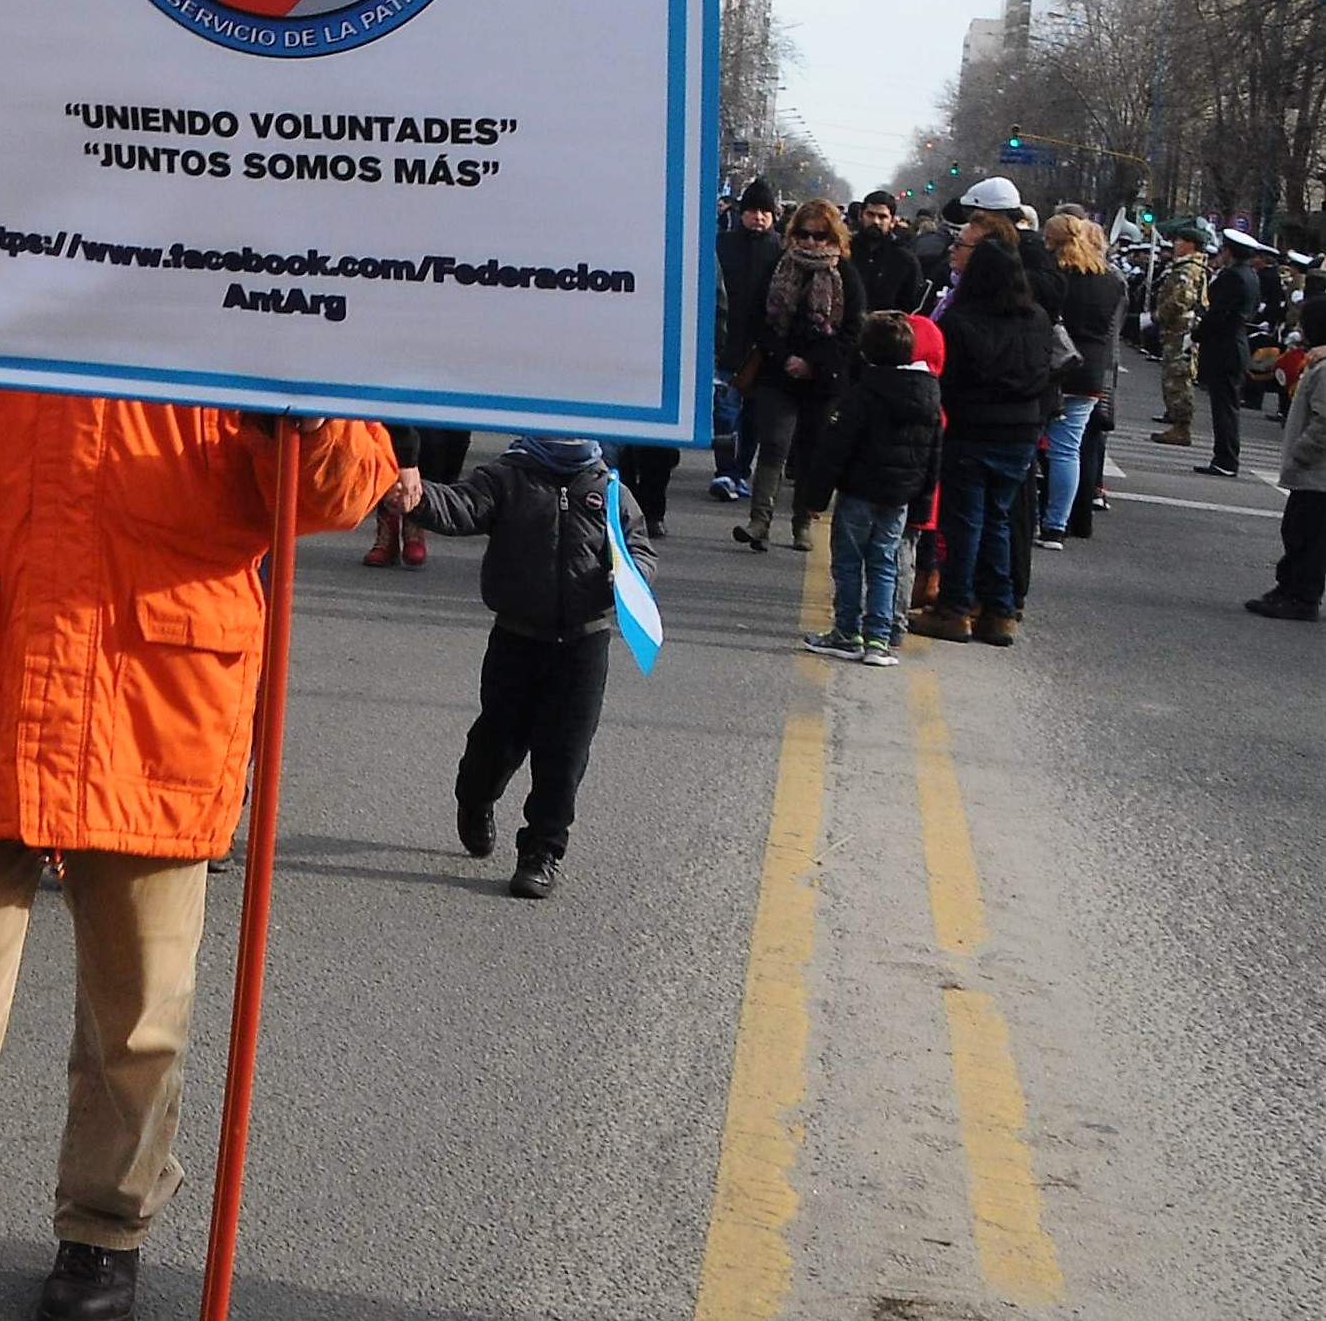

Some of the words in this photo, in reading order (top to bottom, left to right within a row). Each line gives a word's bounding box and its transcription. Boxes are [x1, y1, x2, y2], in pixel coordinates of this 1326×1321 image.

[283, 28, 317, 46] DE
[323, 22, 357, 41] LA
[64, 103, 240, 137] “UNIENDO
[251, 114, 518, 145] VOLUNTADES”
[83, 143, 233, 177] “JUNTOS
[243, 153, 383, 182] SOMOS
[393, 155, 501, 186] MÁS”
[223, 284, 347, 321] AntArg
